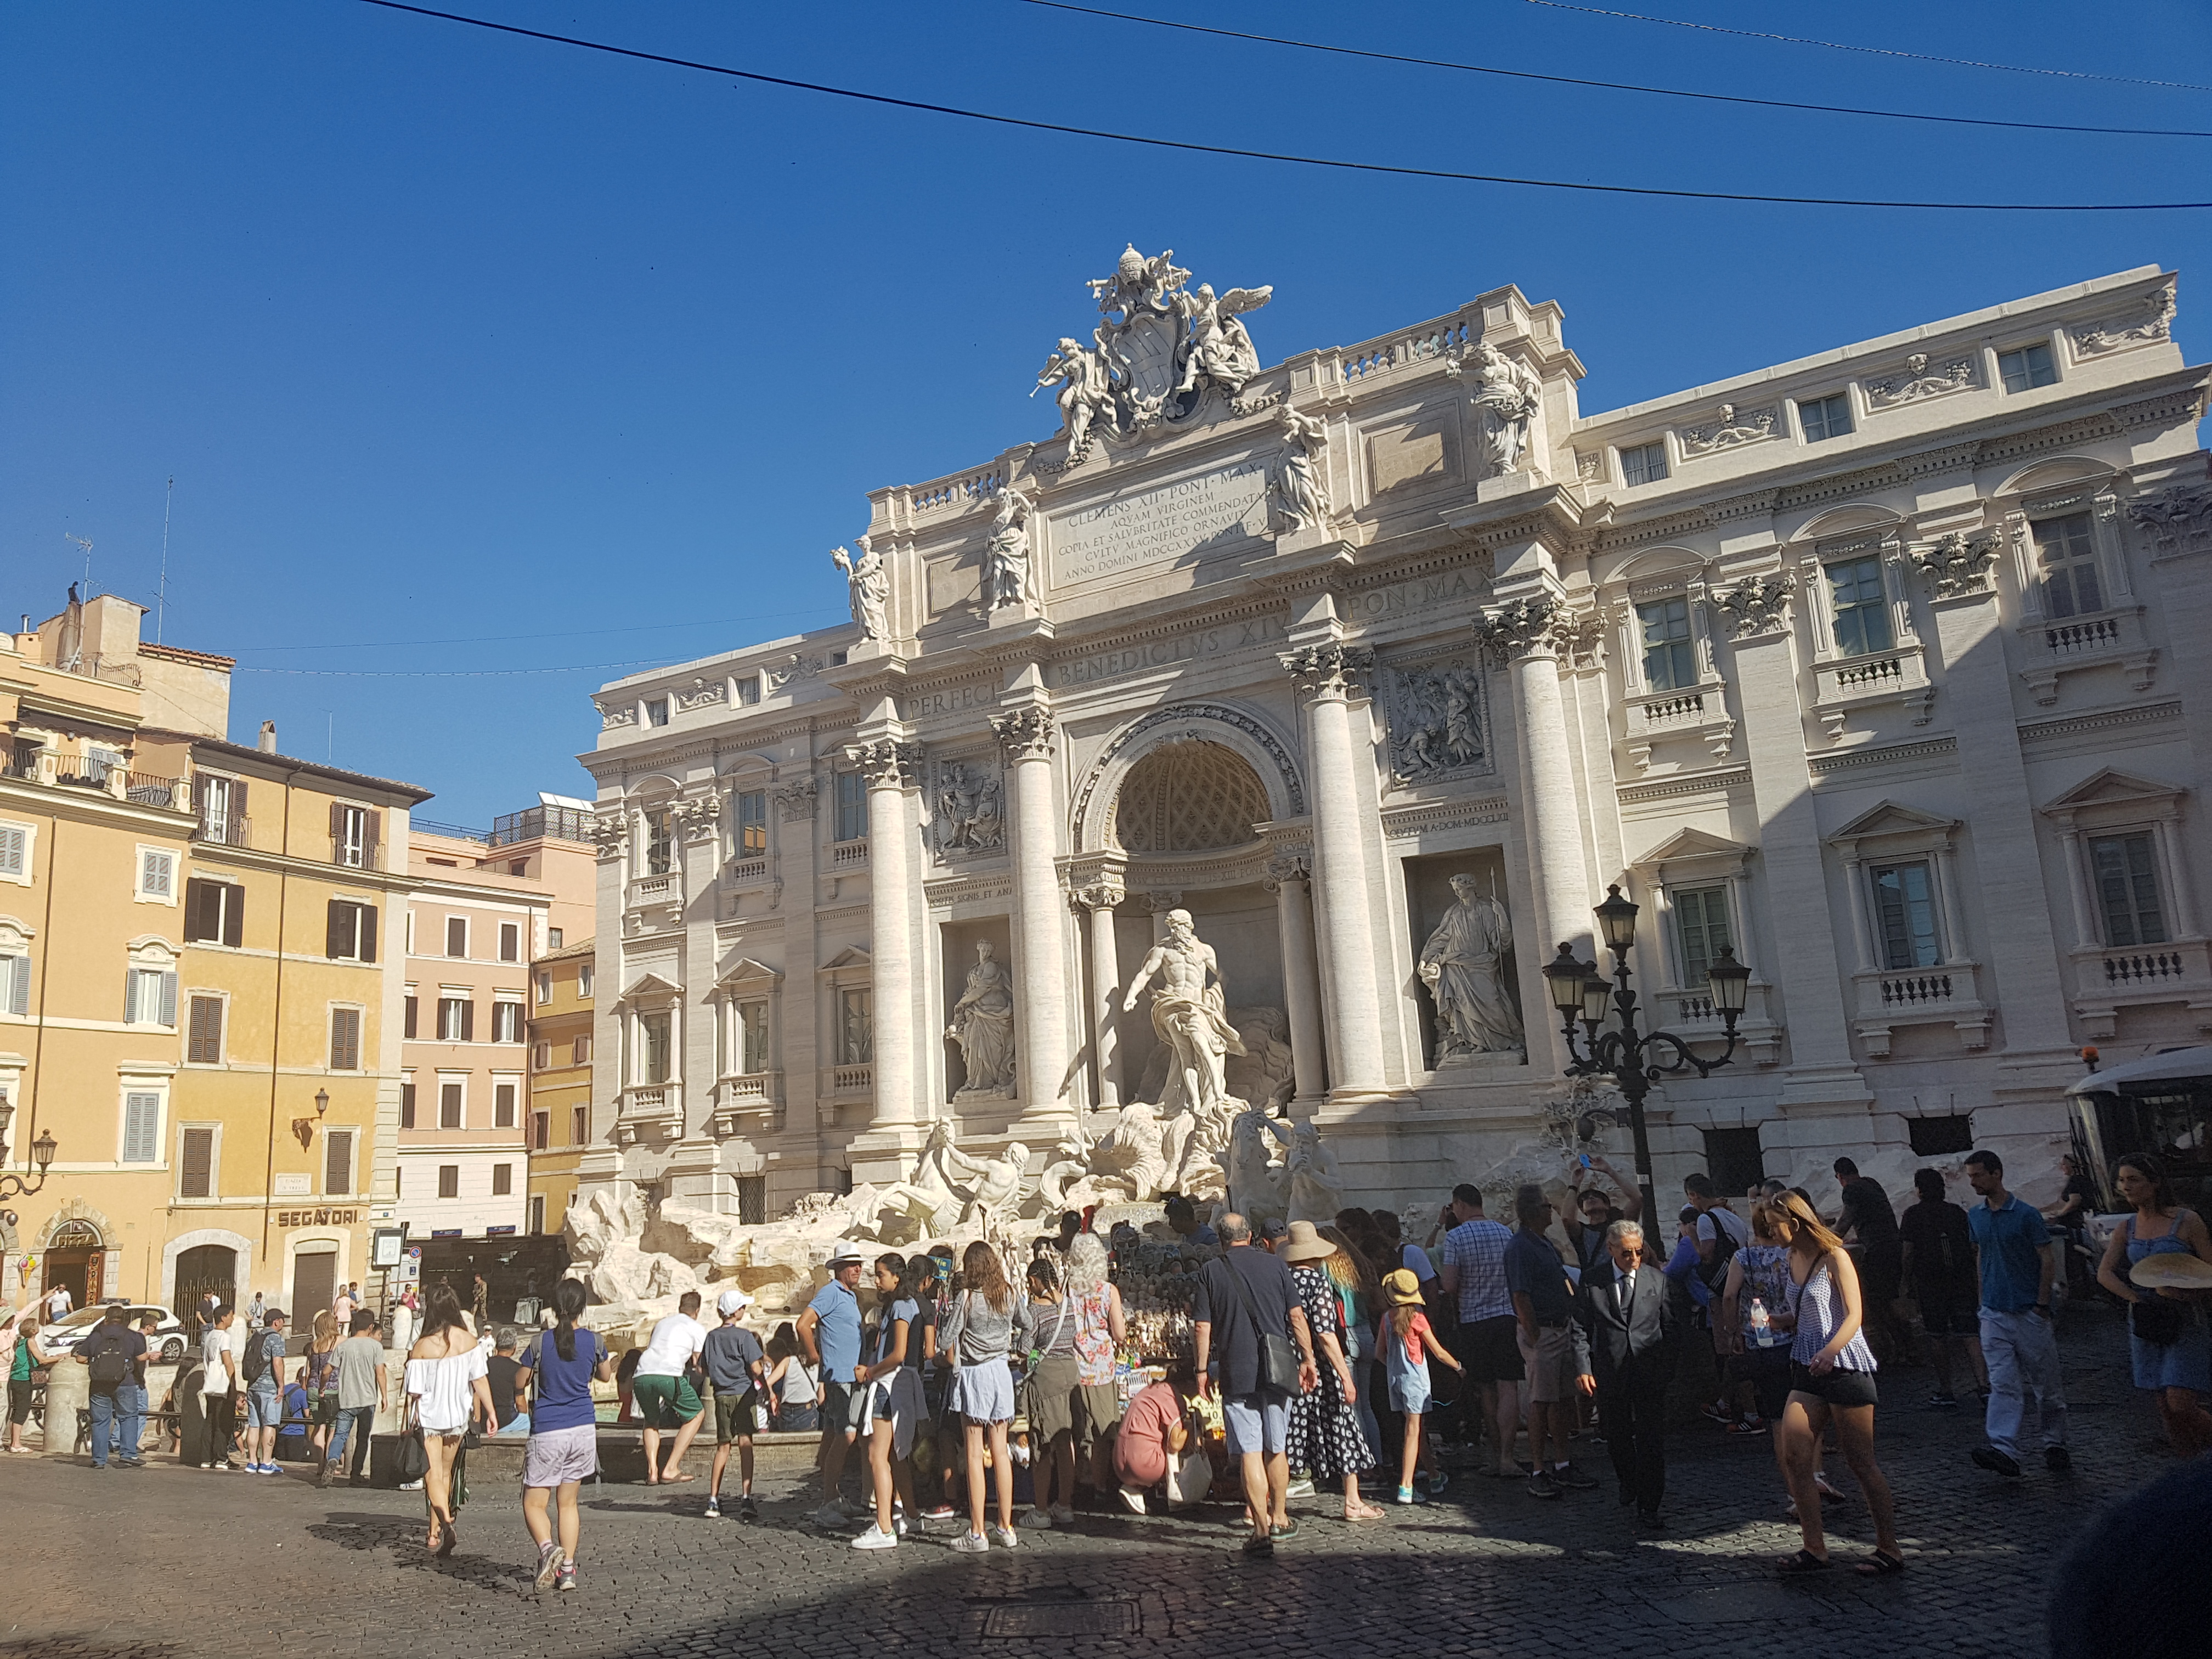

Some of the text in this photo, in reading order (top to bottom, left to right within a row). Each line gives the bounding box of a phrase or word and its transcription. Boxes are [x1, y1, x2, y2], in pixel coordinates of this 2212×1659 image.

[1068, 503, 1131, 527] CLEMENS
[1110, 492, 1214, 529] AQVAM VIRGINEM
[1059, 541, 1088, 556] COPIA
[1093, 537, 1104, 546] ET
[1108, 515, 1177, 543] SALVBRITATE
[1085, 509, 1245, 561] CVLTV MAGNIFICO ORNAVIT
[1064, 565, 1094, 580] ANNO
[1098, 553, 1138, 572] DOMINI
[1058, 631, 1219, 685] BENEDICTVS
[984, 890, 992, 899] ET
[279, 1209, 357, 1227] SEGATORI
[56, 1233, 94, 1247] PIZZA
